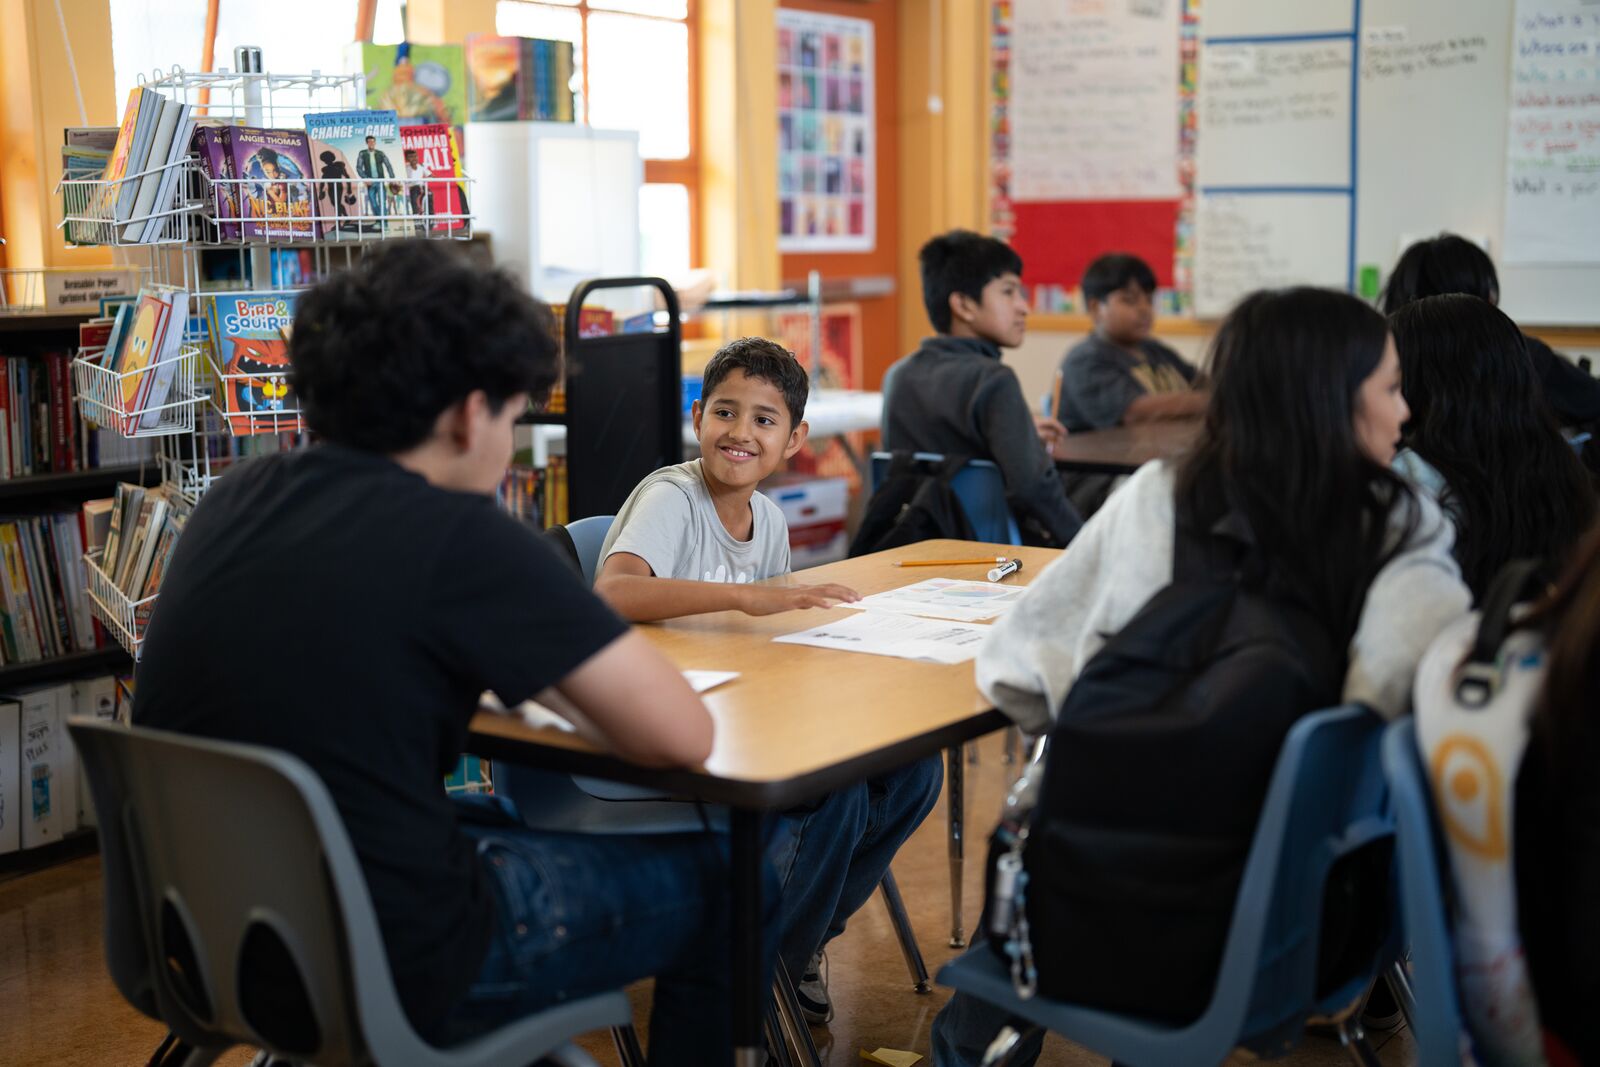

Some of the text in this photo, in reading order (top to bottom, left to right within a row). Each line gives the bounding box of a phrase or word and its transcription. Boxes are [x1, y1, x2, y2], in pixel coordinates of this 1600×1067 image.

[340, 116, 393, 125] KAEPERNICK
[311, 125, 354, 140] CHANGE
[365, 124, 396, 137] GAME
[239, 134, 302, 146] ANGIE THOMAS
[423, 148, 451, 170] ALI
